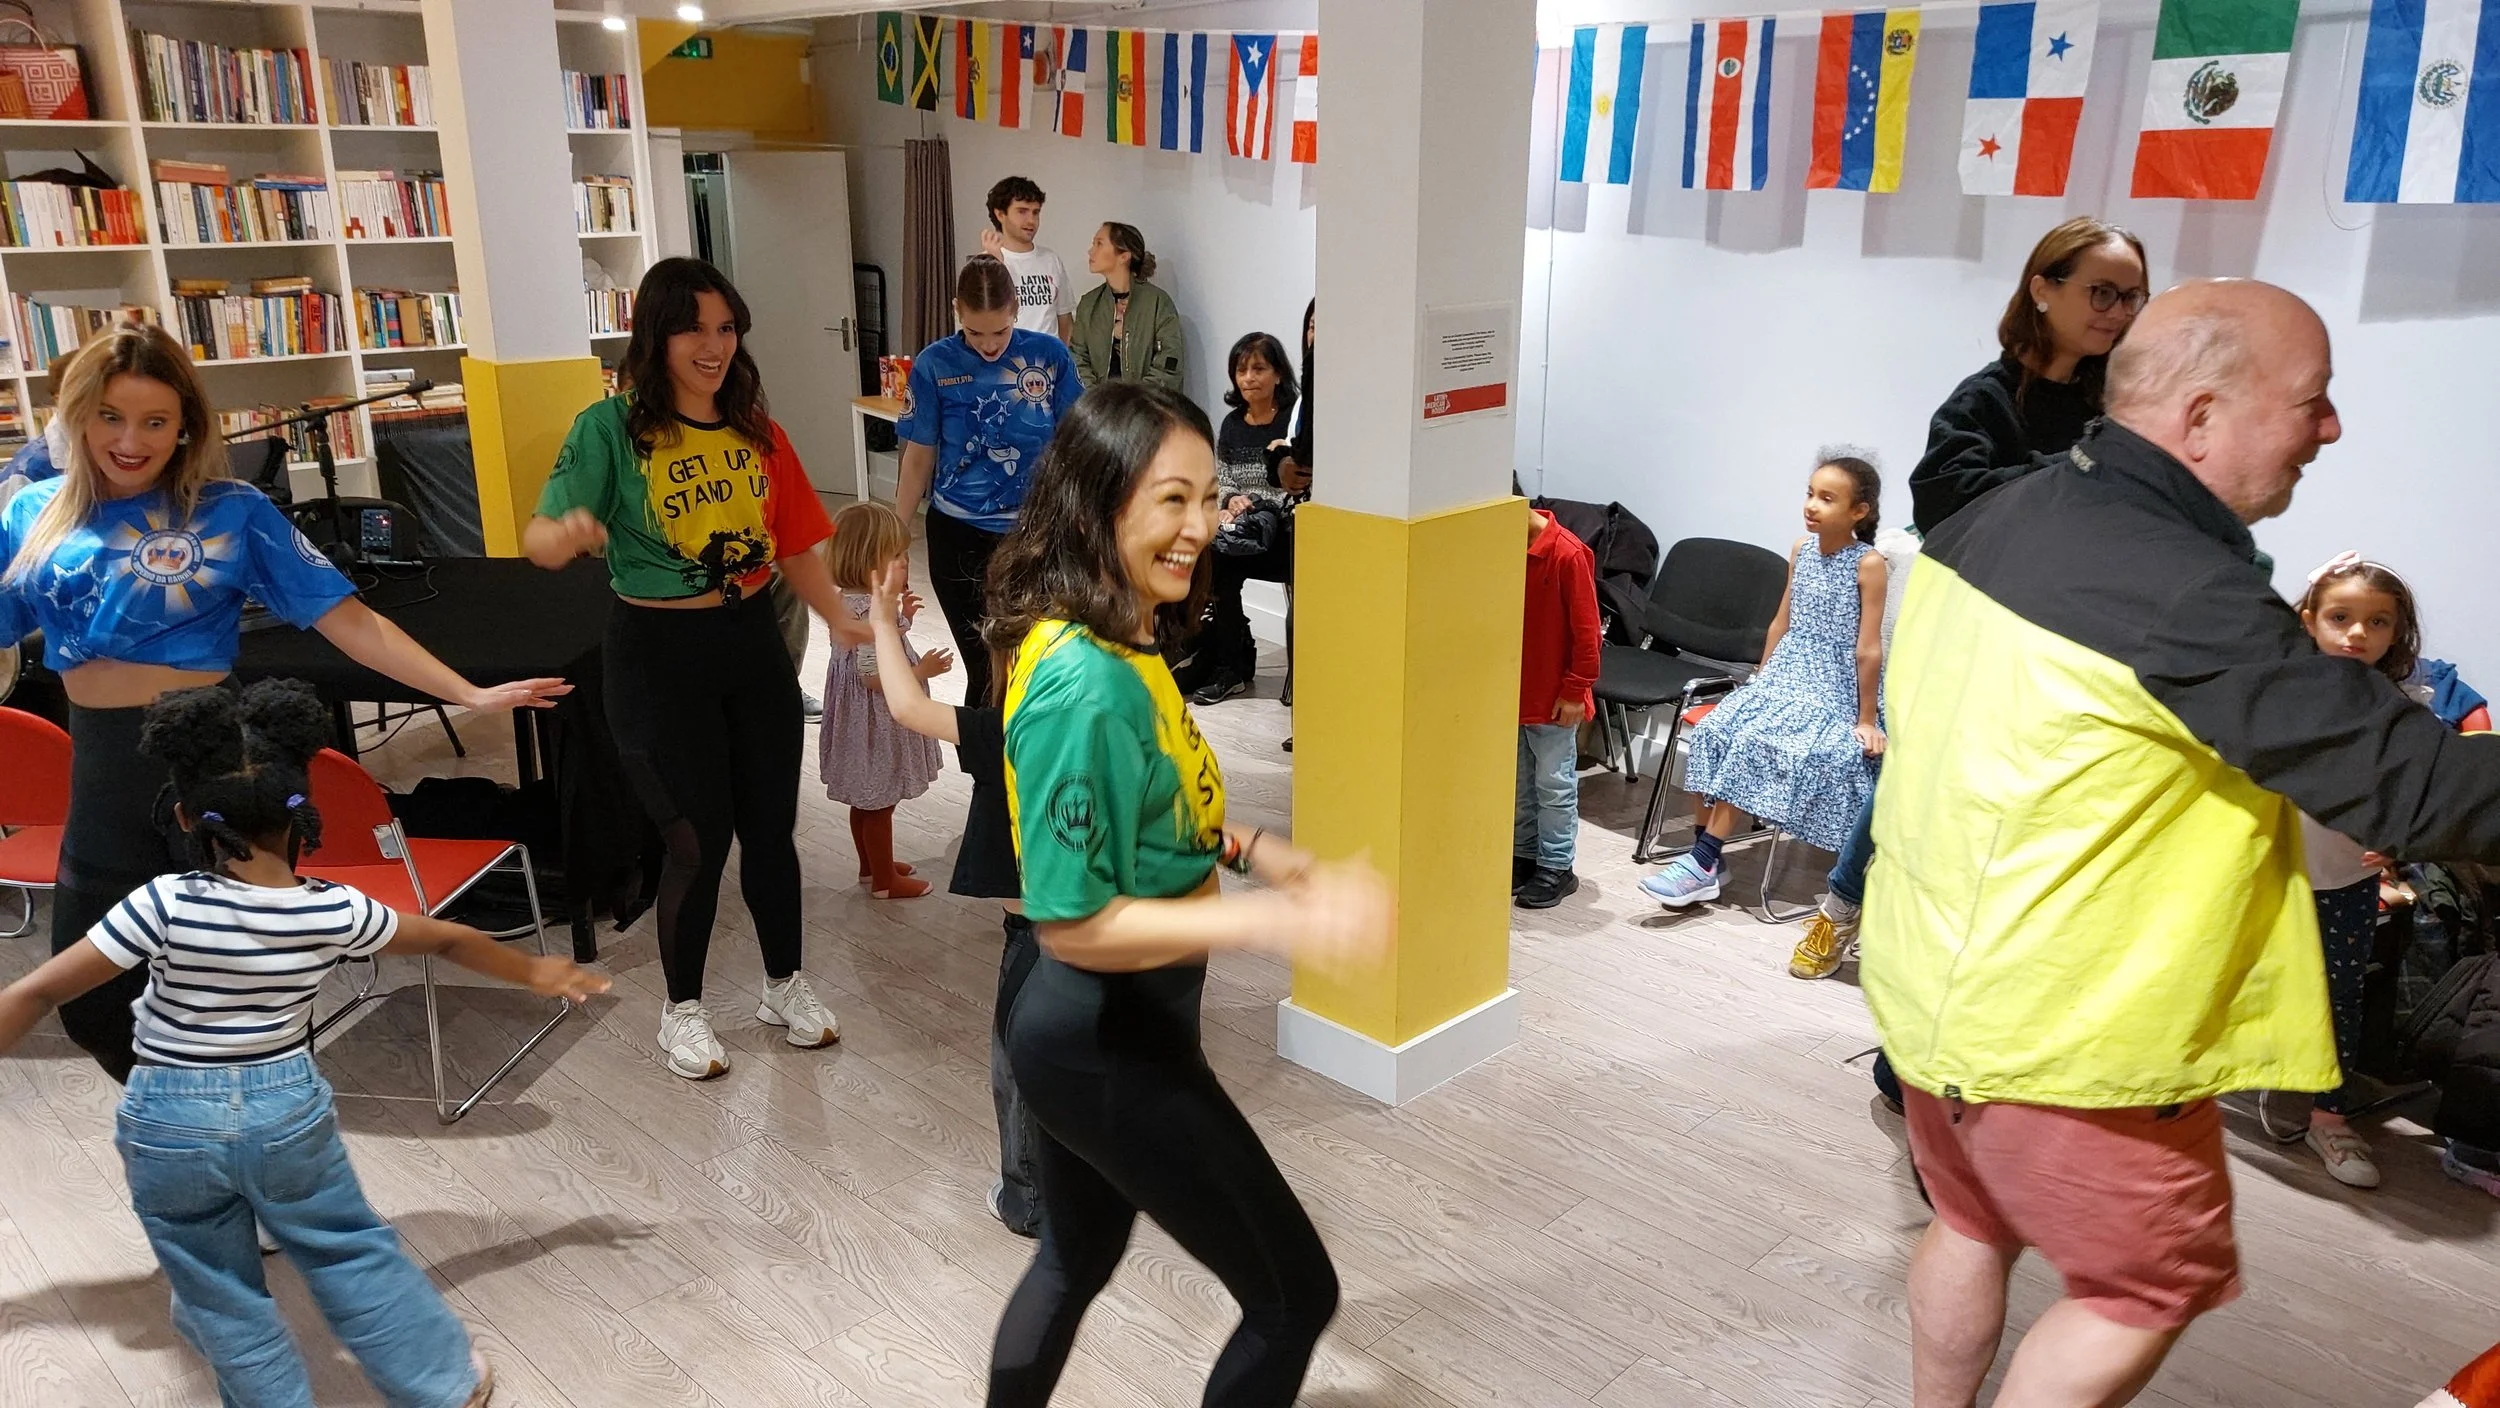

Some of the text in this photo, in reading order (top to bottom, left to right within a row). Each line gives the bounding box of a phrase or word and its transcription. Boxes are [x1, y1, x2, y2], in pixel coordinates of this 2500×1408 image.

[1021, 274, 1050, 285] LATIN
[1015, 285, 1052, 296] ERICAN
[1020, 294, 1053, 307] HOUSE
[668, 448, 759, 484] GET UP,
[663, 475, 769, 519] STAND UP
